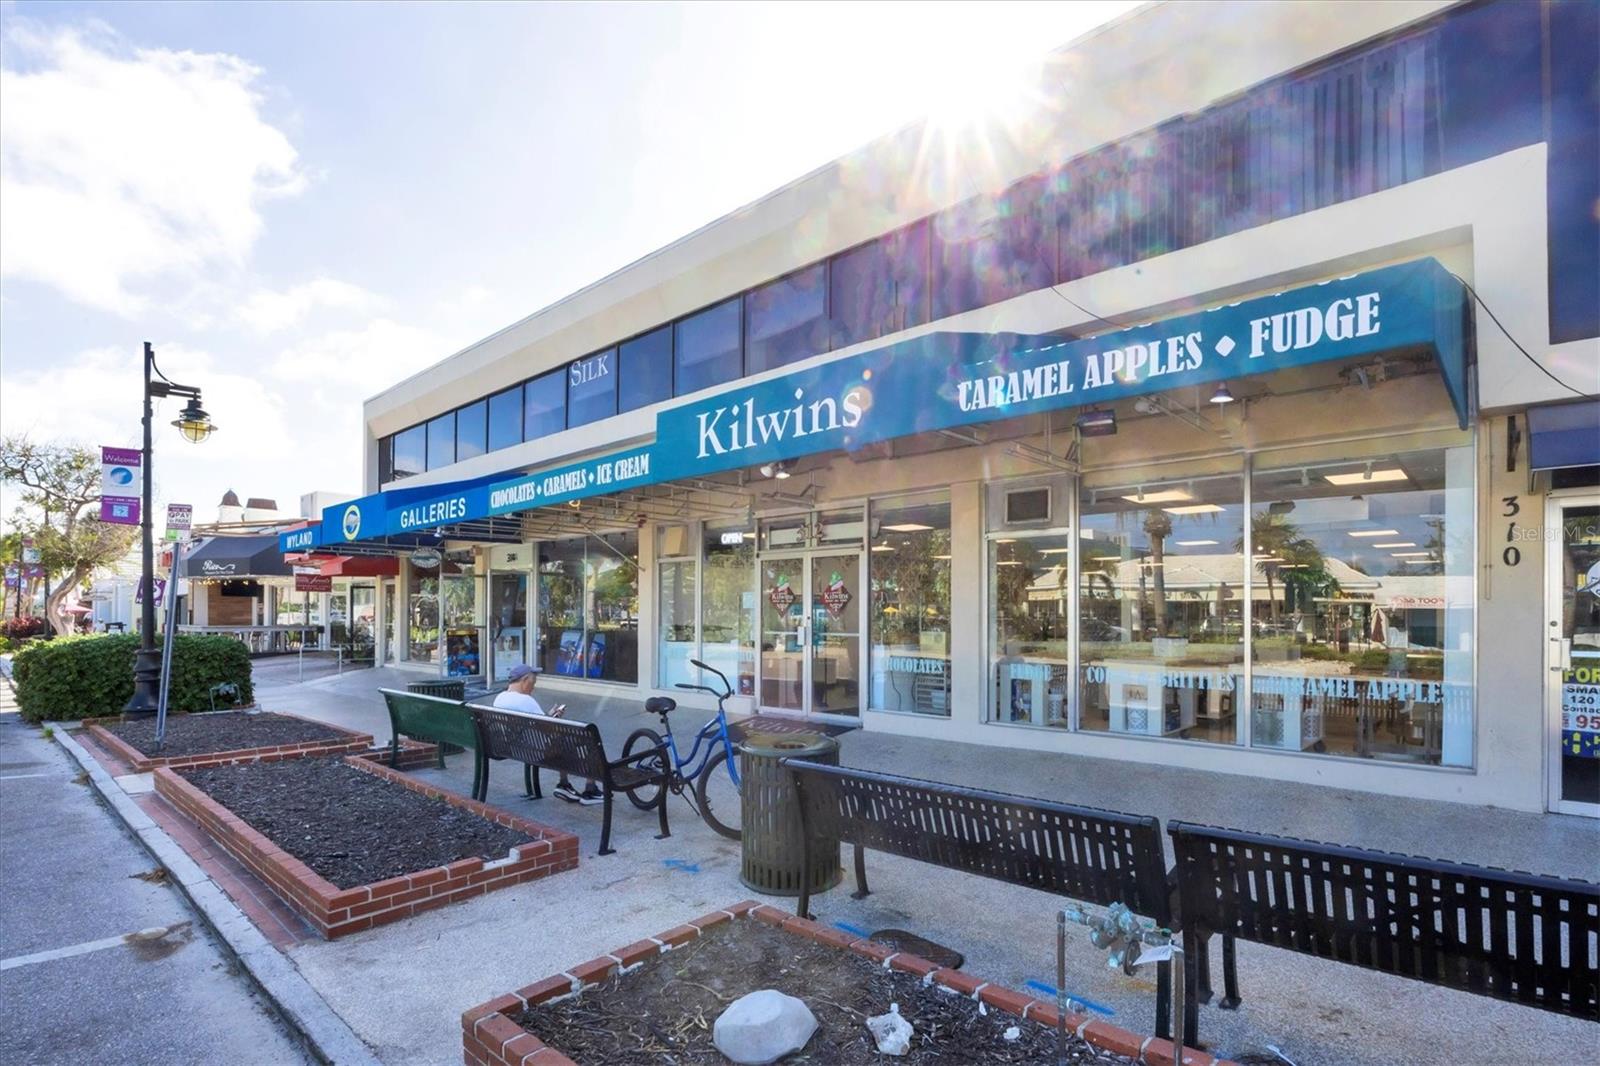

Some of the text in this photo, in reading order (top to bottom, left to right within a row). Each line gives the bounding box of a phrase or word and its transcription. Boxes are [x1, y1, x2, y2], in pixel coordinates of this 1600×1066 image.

[957, 291, 1381, 413] CARAMEL APPLES FUDGE
[696, 387, 864, 459] Kilwins
[104, 453, 140, 465] Welcome
[491, 453, 651, 509] CHOCOLATES CARAMELS ICE CREAM
[400, 497, 467, 528] GALLERIES
[286, 531, 313, 549] WYLAND
[824, 590, 850, 601] Kilwins
[886, 657, 945, 675] HOCOLATES
[1570, 696, 1595, 705] 120
